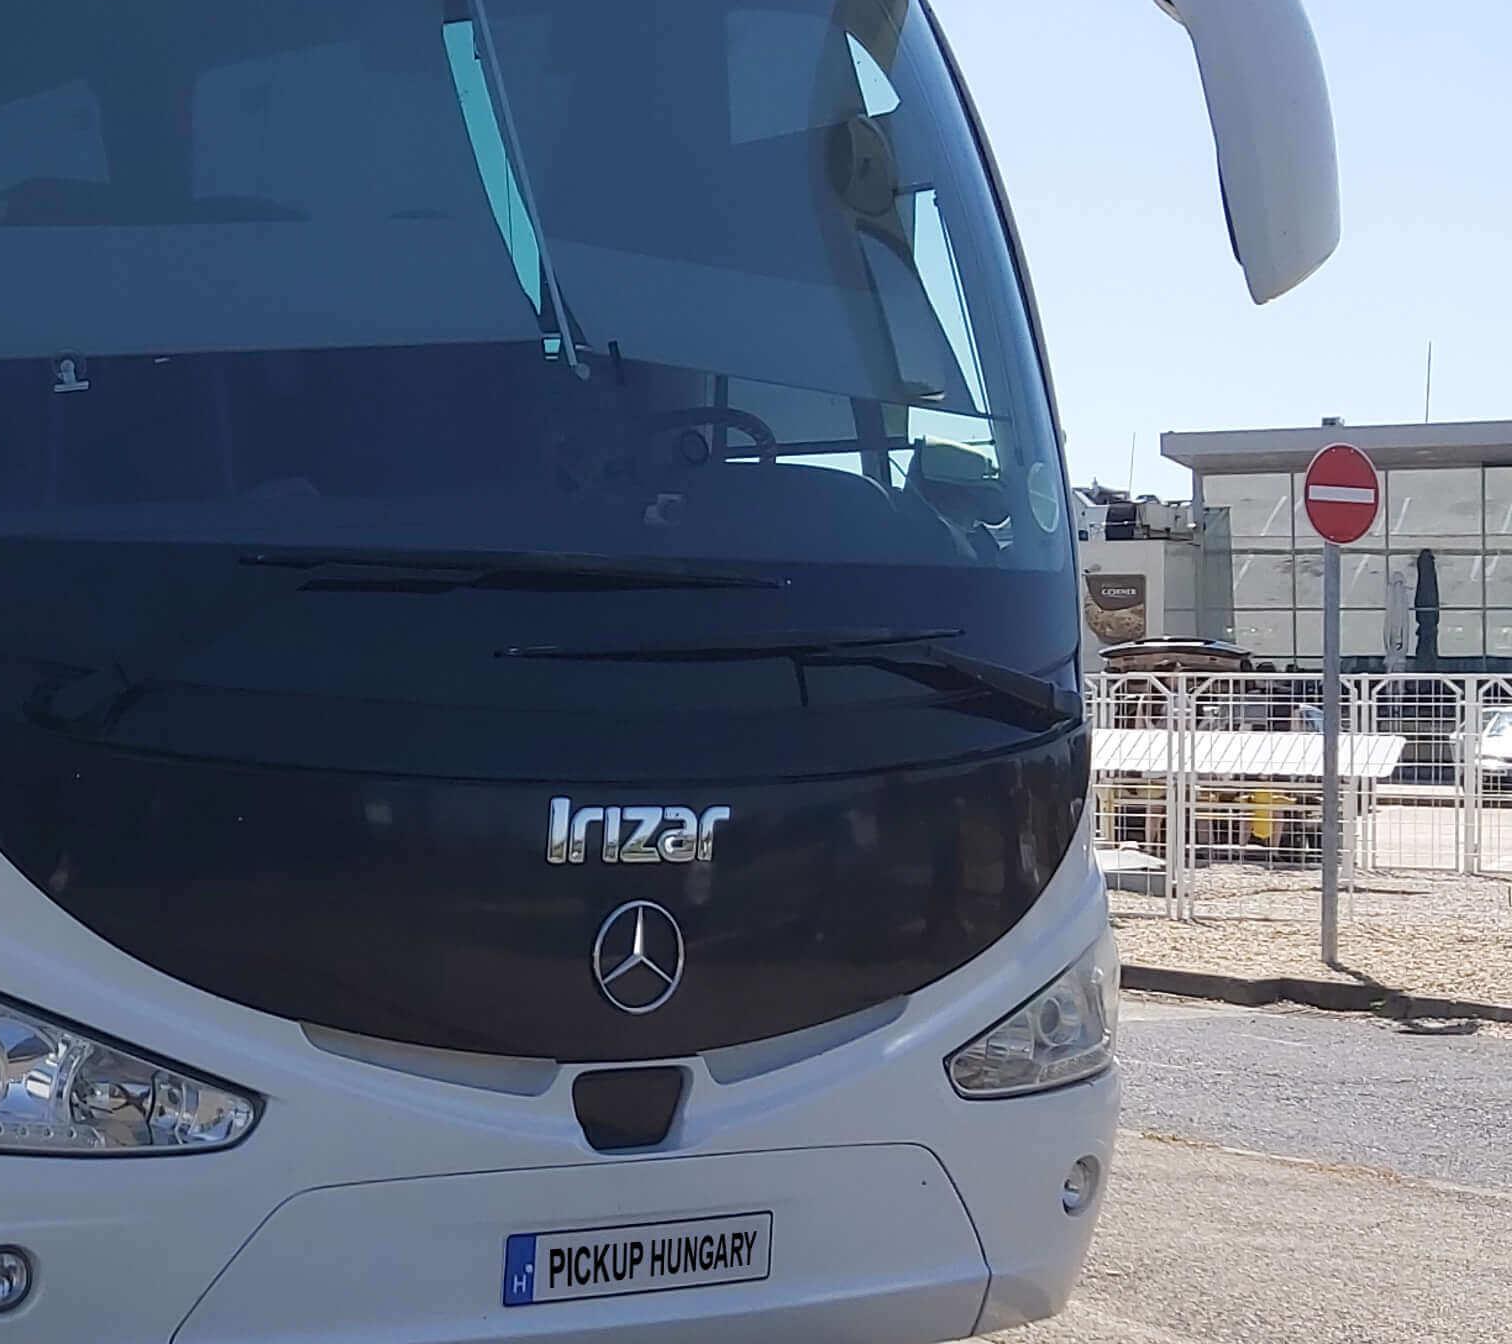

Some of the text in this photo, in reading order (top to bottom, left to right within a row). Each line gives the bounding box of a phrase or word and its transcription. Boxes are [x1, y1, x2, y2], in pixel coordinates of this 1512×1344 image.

[546, 796, 732, 864] Irizar
[549, 1241, 645, 1289] PICKUP
[649, 1229, 758, 1278] HUNGARY
